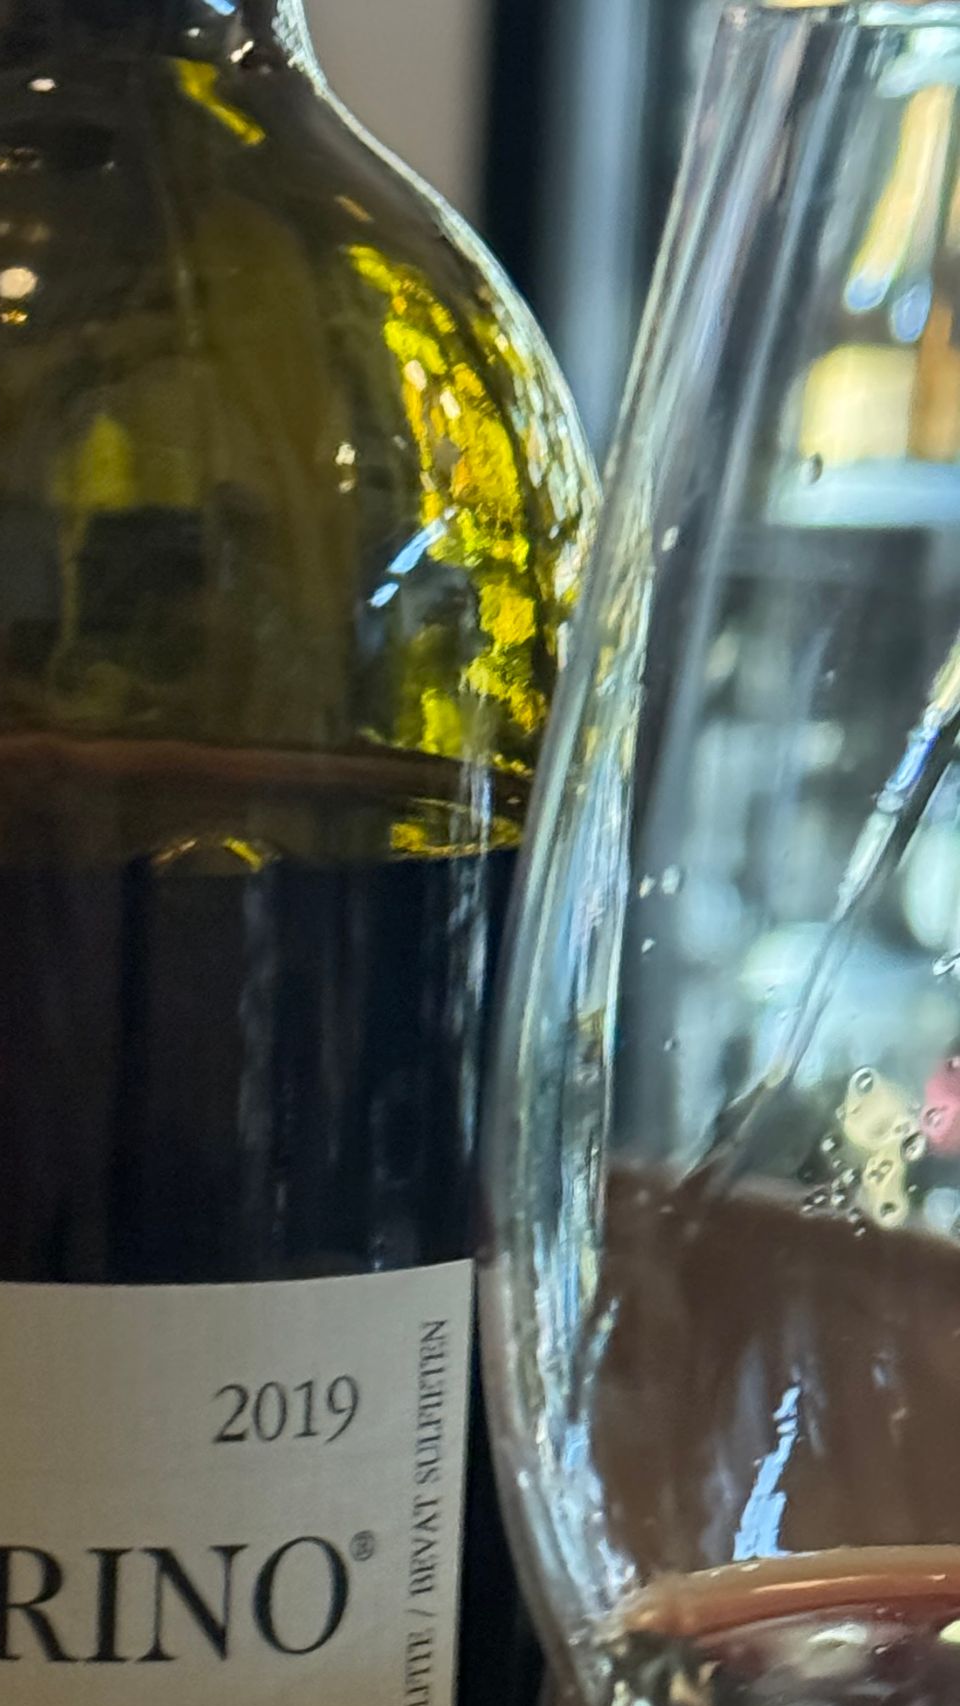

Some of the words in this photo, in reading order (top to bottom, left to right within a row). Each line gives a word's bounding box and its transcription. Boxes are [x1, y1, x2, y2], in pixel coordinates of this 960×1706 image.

[212, 1375, 360, 1445] 2019
[413, 1319, 449, 1484] SULFIETEN
[407, 1494, 442, 1598] BEVAT
